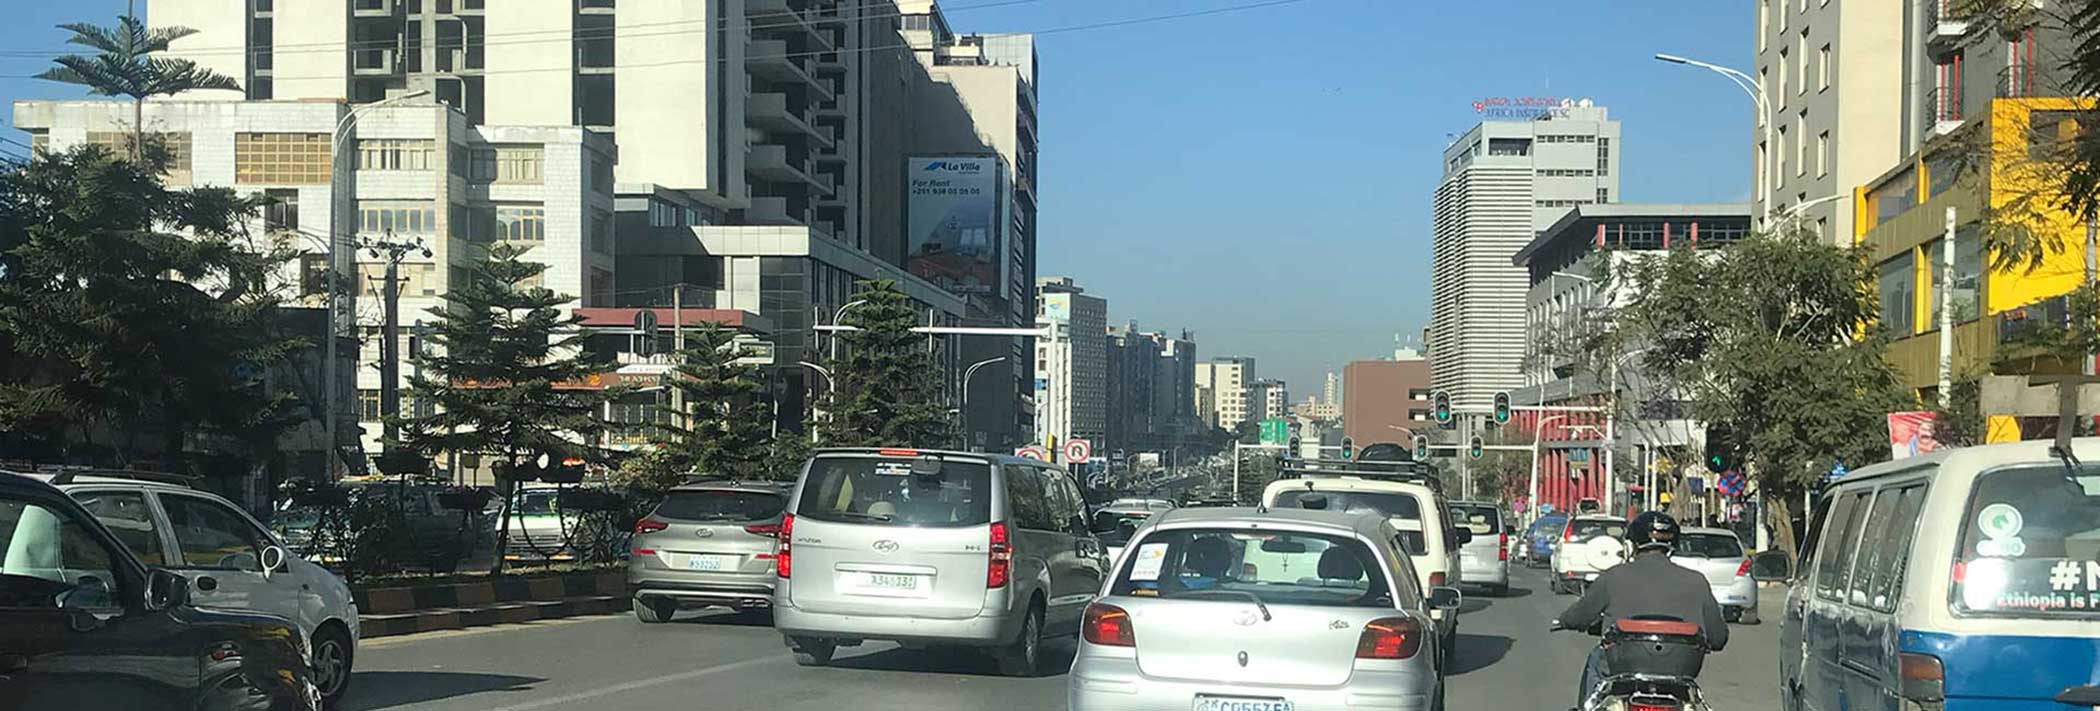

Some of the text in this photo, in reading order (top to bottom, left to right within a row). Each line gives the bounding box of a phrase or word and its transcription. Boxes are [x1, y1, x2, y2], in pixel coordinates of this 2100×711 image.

[948, 161, 980, 171] La Villa
[2069, 593, 2086, 608] is
